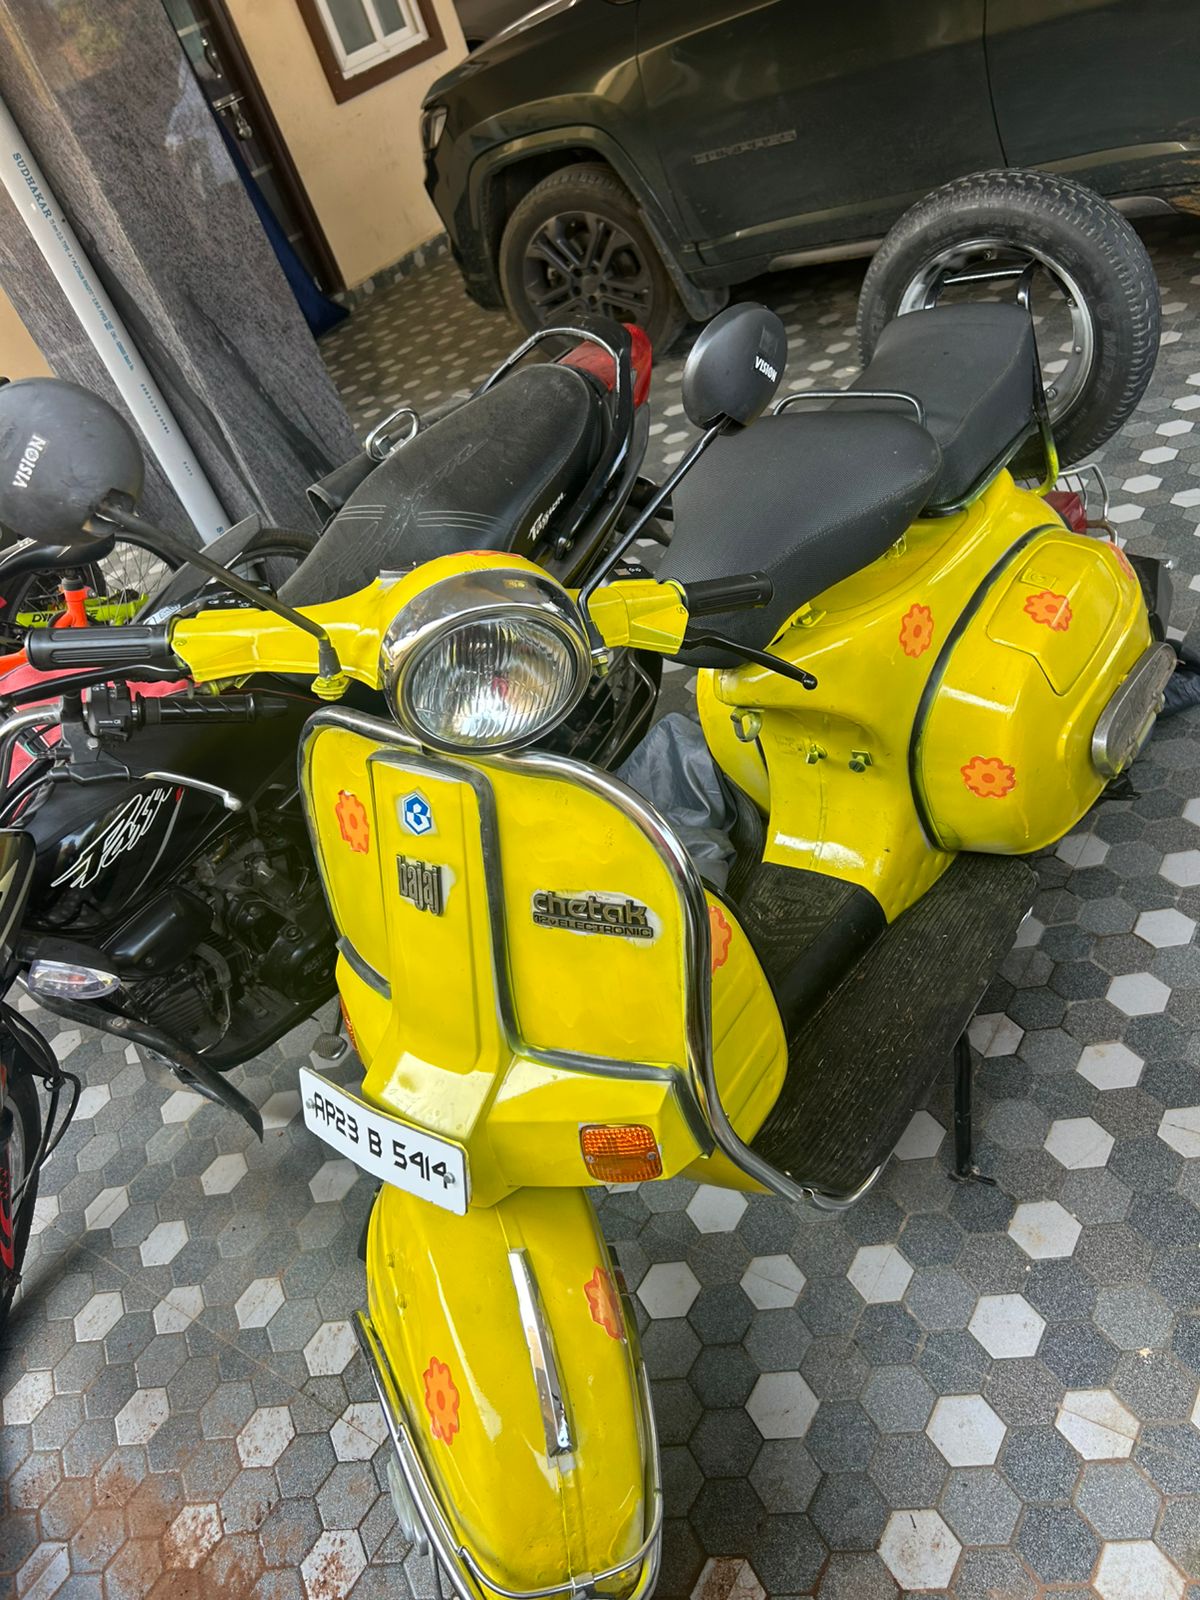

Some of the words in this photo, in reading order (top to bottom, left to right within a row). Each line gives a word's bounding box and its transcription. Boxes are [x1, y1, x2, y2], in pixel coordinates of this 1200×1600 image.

[12, 152, 53, 219] SUDHAKAR
[754, 355, 778, 383] VISION
[12, 434, 47, 488] VISION
[396, 853, 444, 917] bajaj
[533, 890, 647, 925] chetak
[559, 920, 651, 937] ELECTRONIC
[314, 1091, 360, 1144] AP23
[367, 1127, 383, 1158] B
